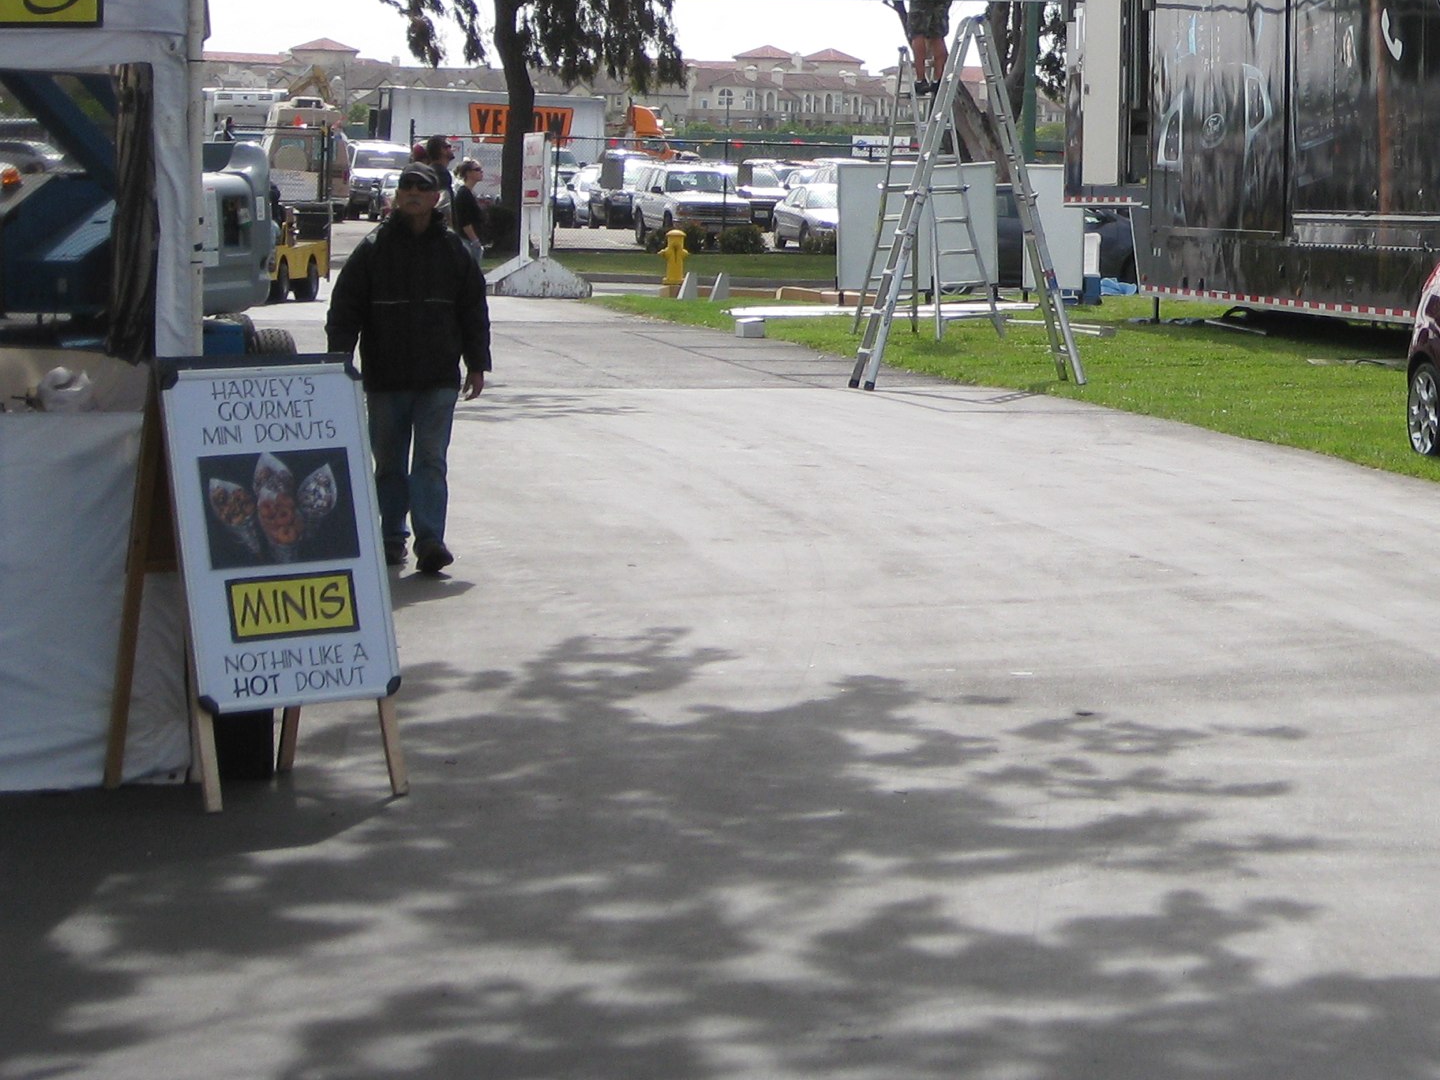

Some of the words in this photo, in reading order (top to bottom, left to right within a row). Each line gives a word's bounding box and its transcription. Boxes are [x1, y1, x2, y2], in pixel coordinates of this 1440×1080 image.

[475, 108, 568, 136] YEOW
[217, 399, 314, 422] GOURMET
[202, 424, 243, 446] MINI
[254, 419, 337, 444] DONUTS
[240, 581, 346, 628] MINIS
[224, 647, 303, 675] NOTHIN
[308, 644, 345, 667] LIKE
[353, 642, 370, 663] A
[233, 672, 281, 699] HOT
[294, 665, 366, 693] DONUT
